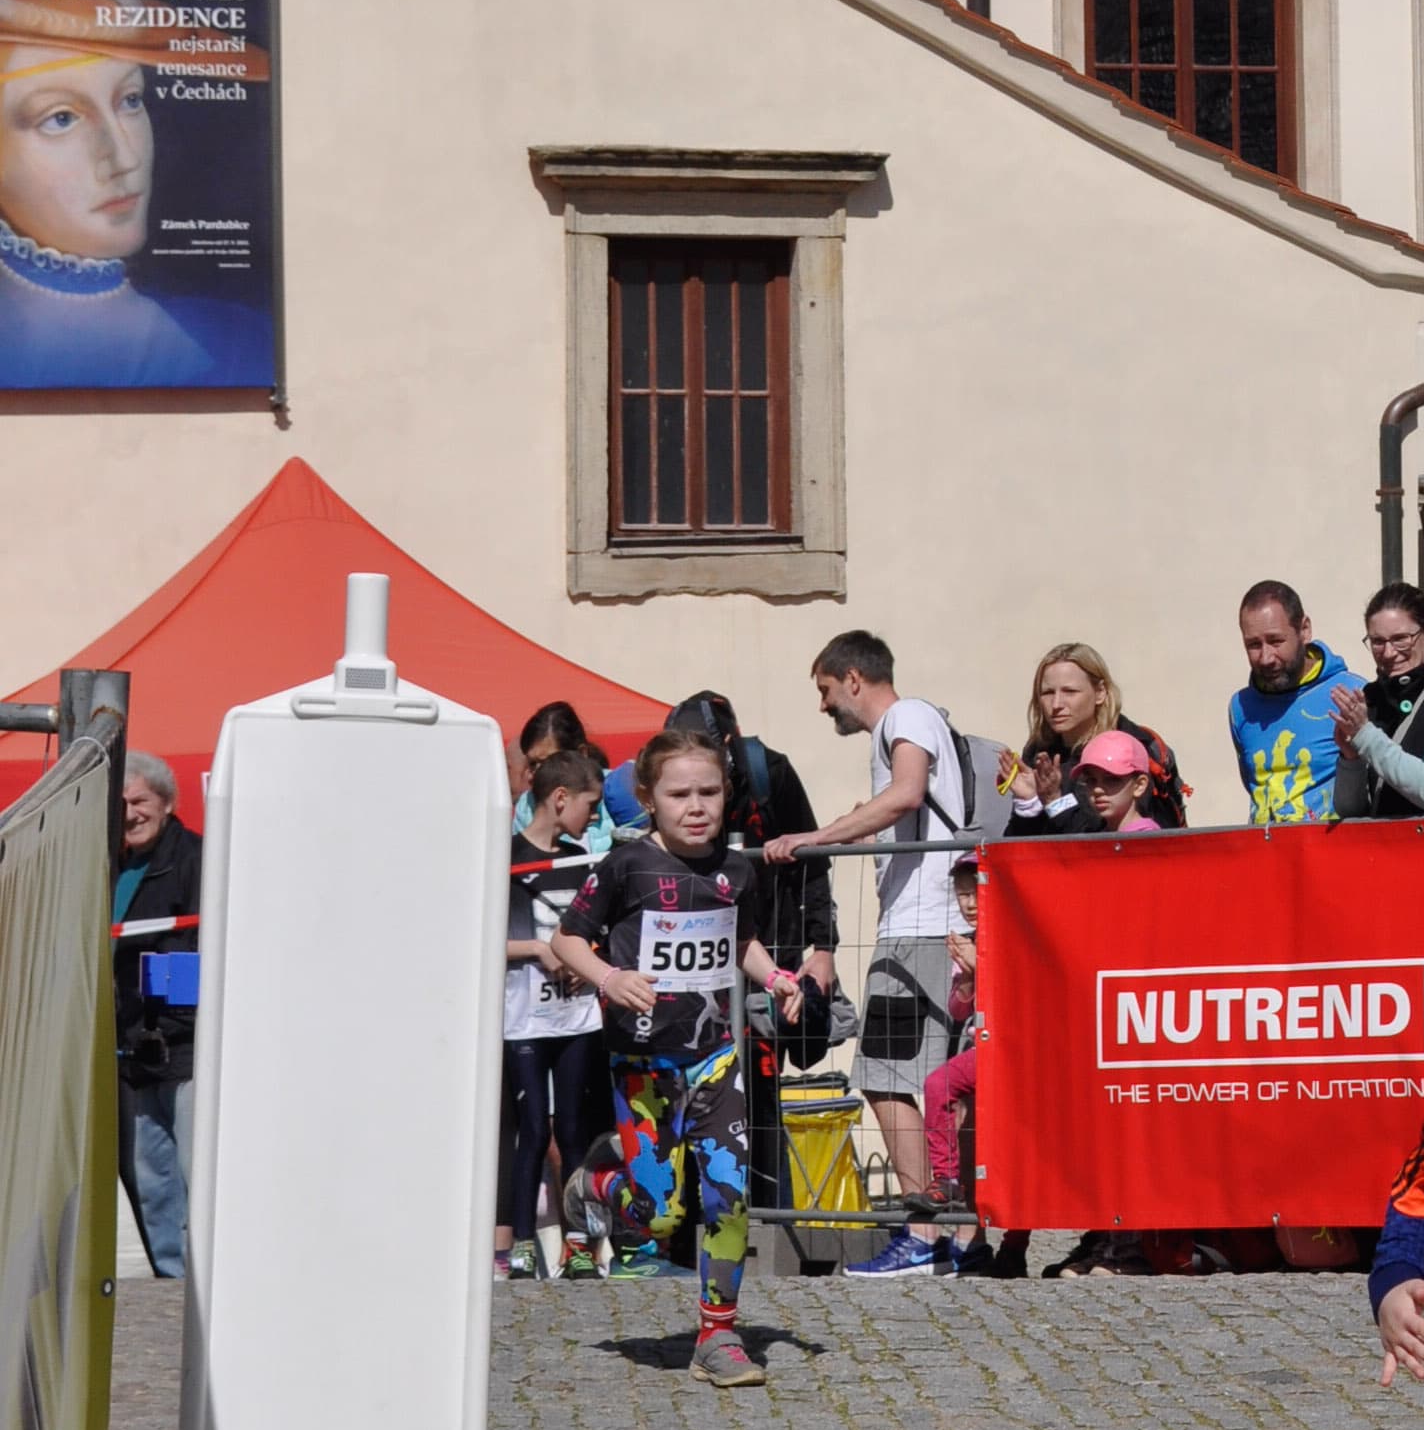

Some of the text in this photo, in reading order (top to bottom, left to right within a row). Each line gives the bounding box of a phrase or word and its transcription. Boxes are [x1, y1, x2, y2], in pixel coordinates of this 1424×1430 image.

[95, 7, 246, 28] REZIDENCE
[169, 35, 246, 55] nejstarší
[157, 63, 247, 75] renesance
[156, 80, 247, 100] v Čechách
[651, 937, 730, 972] 5039
[1117, 982, 1411, 1044] NUTREND
[1105, 1078, 1424, 1103] THE POWER OF NUTRITION
